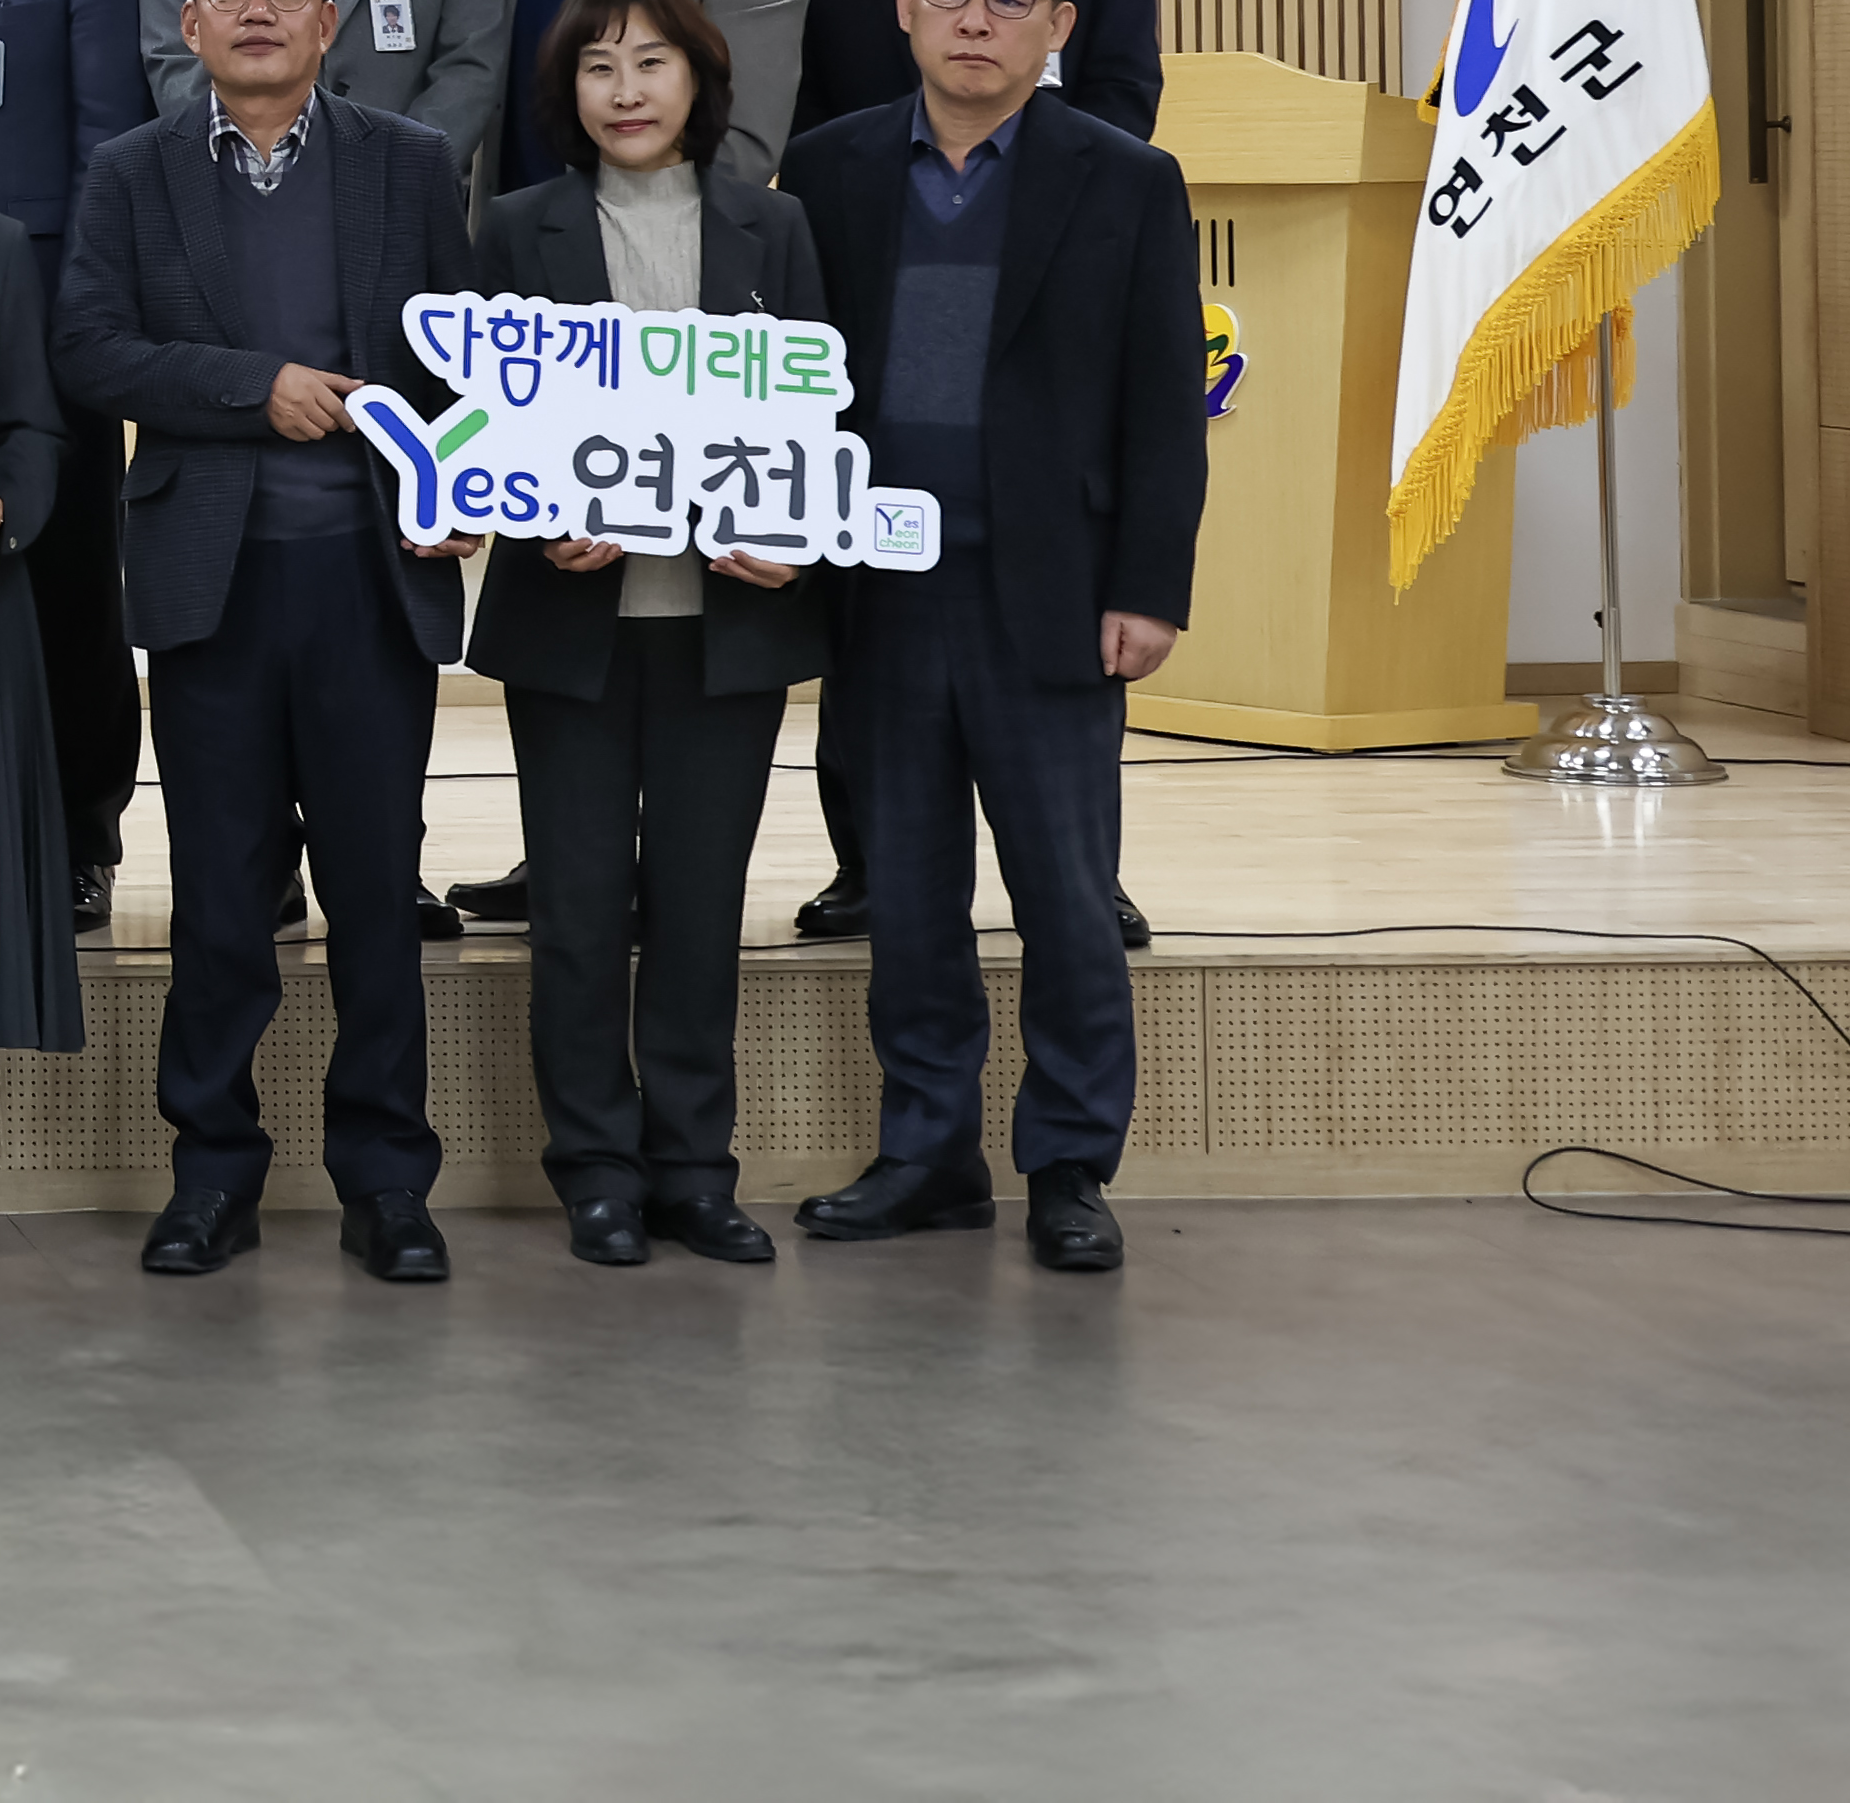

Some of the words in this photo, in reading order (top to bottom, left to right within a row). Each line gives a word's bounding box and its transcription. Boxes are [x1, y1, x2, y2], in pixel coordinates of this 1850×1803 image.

[1428, 19, 1643, 239] 연천군
[419, 307, 620, 407] 다함께
[639, 323, 839, 401] 미래로
